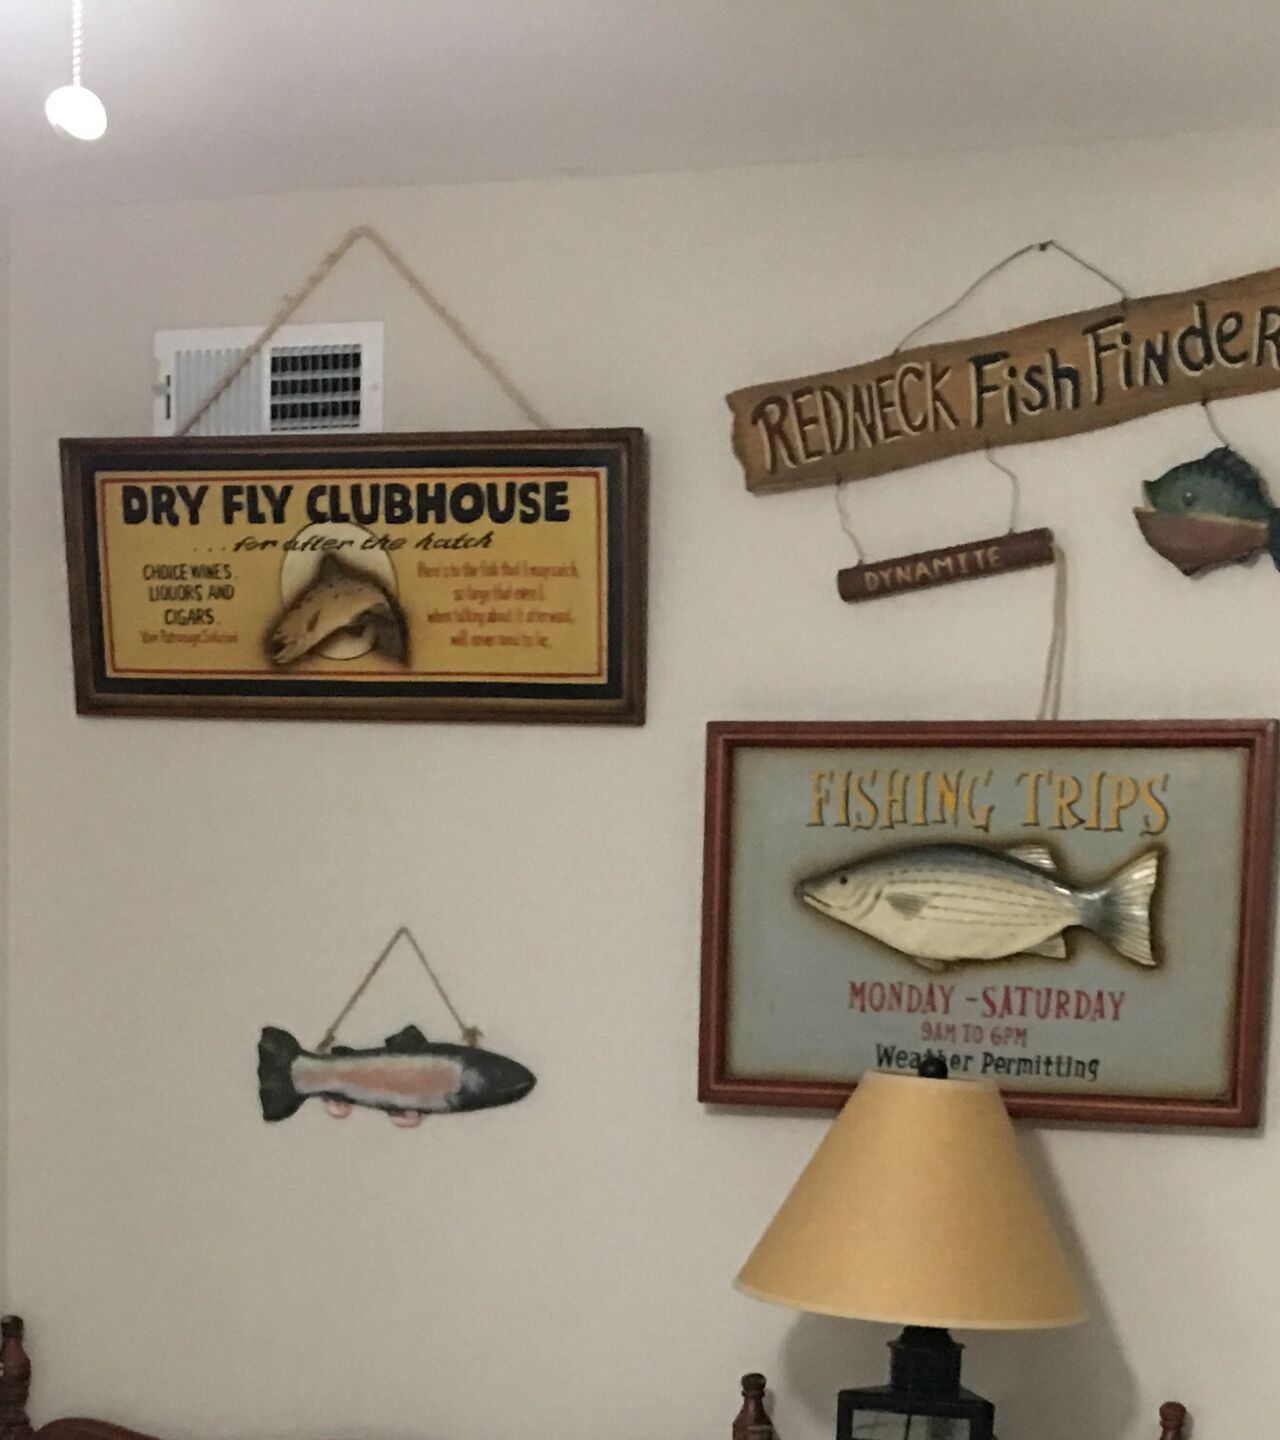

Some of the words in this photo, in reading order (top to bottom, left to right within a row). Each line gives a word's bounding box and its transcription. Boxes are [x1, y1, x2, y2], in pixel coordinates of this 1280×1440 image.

[751, 361, 960, 474] REDNECK
[968, 347, 1083, 428] Fish
[122, 485, 209, 527] DRY
[222, 485, 293, 525] FLY
[306, 480, 571, 525] CLUBHOUSE
[283, 535, 354, 552] after
[361, 532, 407, 551] the
[414, 530, 495, 551] hatch
[142, 563, 188, 581] CHOICE
[862, 547, 1002, 592] DYNAMITE
[149, 584, 203, 602] LIQUORS
[208, 583, 235, 601] AND
[805, 768, 995, 833] FISHING
[1015, 769, 1170, 836] TRIPS
[848, 981, 956, 1015] MONDAY
[921, 1021, 957, 1044] 9AM
[962, 1023, 984, 1044] TO
[991, 1026, 1028, 1047] 6PM
[980, 1052, 1100, 1081] Permitting
